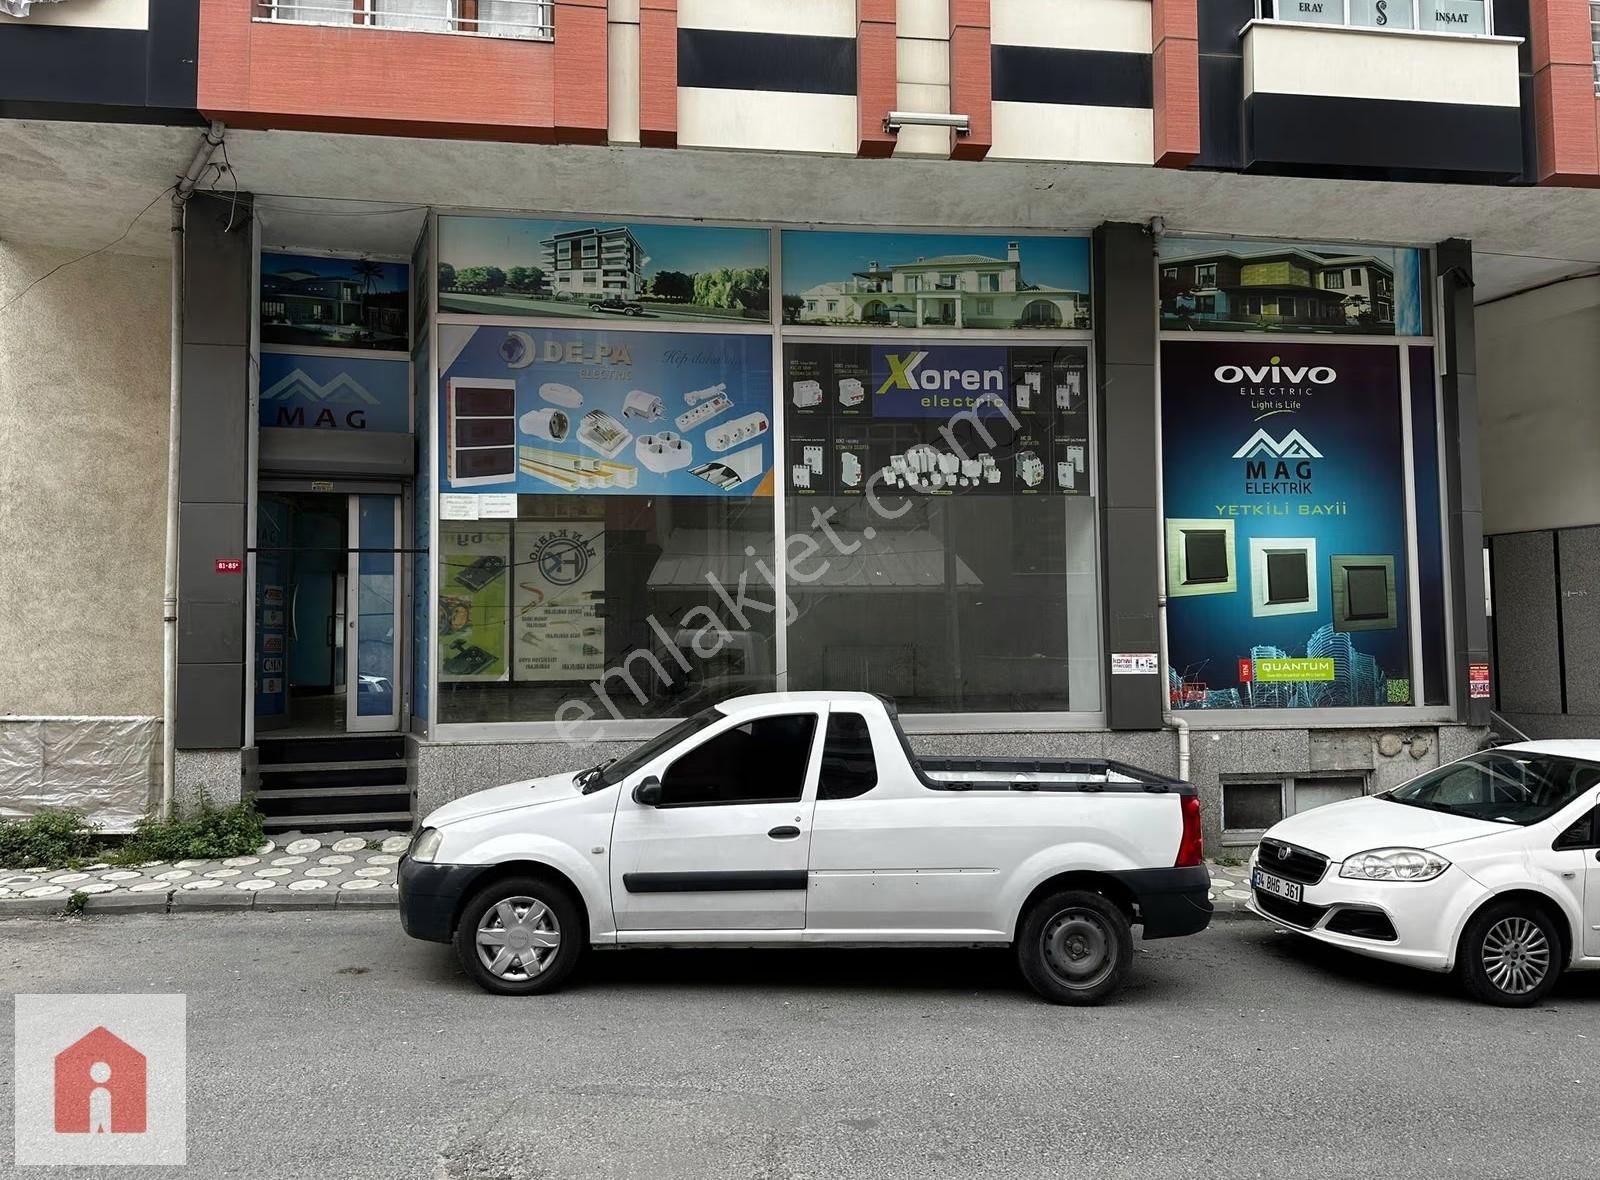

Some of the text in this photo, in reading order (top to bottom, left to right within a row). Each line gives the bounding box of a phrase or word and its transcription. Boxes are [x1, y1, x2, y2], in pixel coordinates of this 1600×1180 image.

[1299, 2, 1323, 13] ERAY
[1435, 9, 1469, 24] İNŞAAT
[1240, 387, 1313, 396] ELECTRIC
[1251, 401, 1301, 411] Light is Life
[276, 405, 367, 429] MAG
[1246, 461, 1312, 480] MAG
[1246, 480, 1312, 495] ELEKTRİK
[1262, 662, 1329, 672] QUANTUM
[1267, 876, 1281, 893] BHG
[1285, 882, 1299, 900] 361
